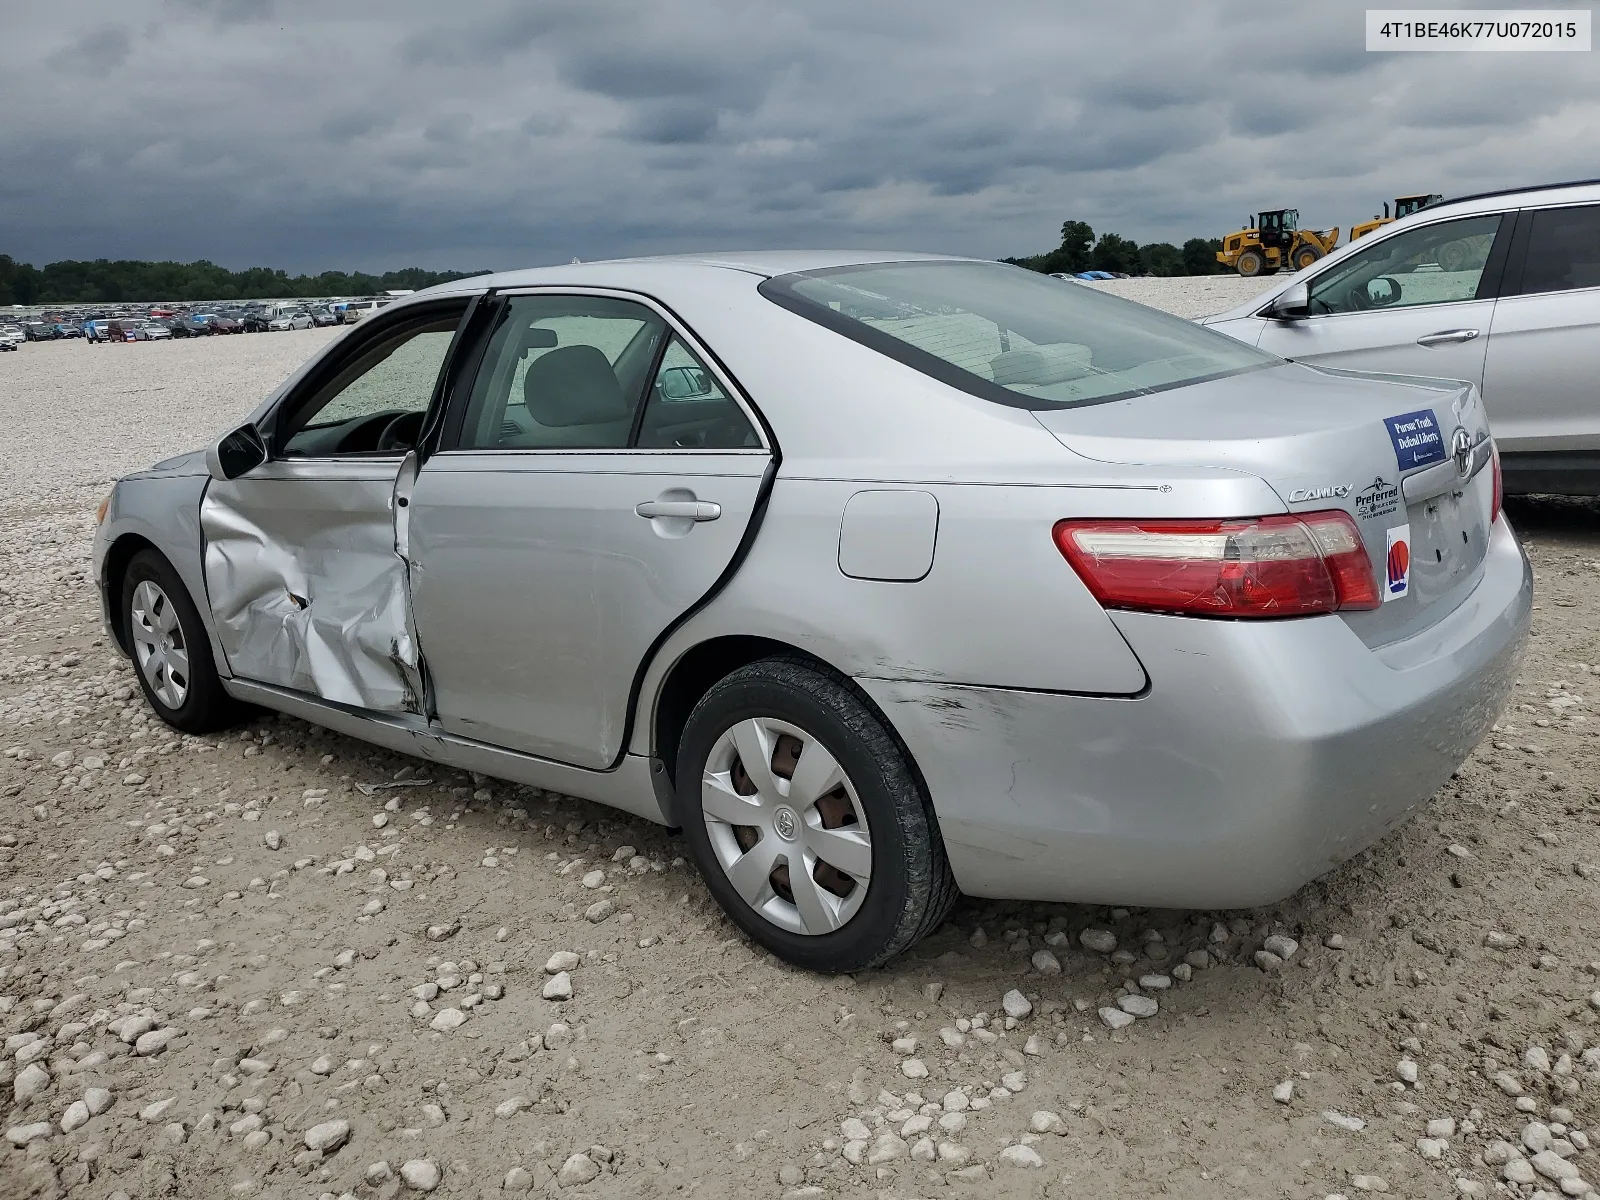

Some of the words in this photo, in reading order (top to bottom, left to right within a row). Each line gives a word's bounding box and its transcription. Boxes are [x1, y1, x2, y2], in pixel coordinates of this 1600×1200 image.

[1394, 423, 1416, 434] Pursue
[1398, 434, 1420, 449] Defend
[1288, 483, 1355, 503] CAMRY
[1356, 486, 1398, 507] Preferred
